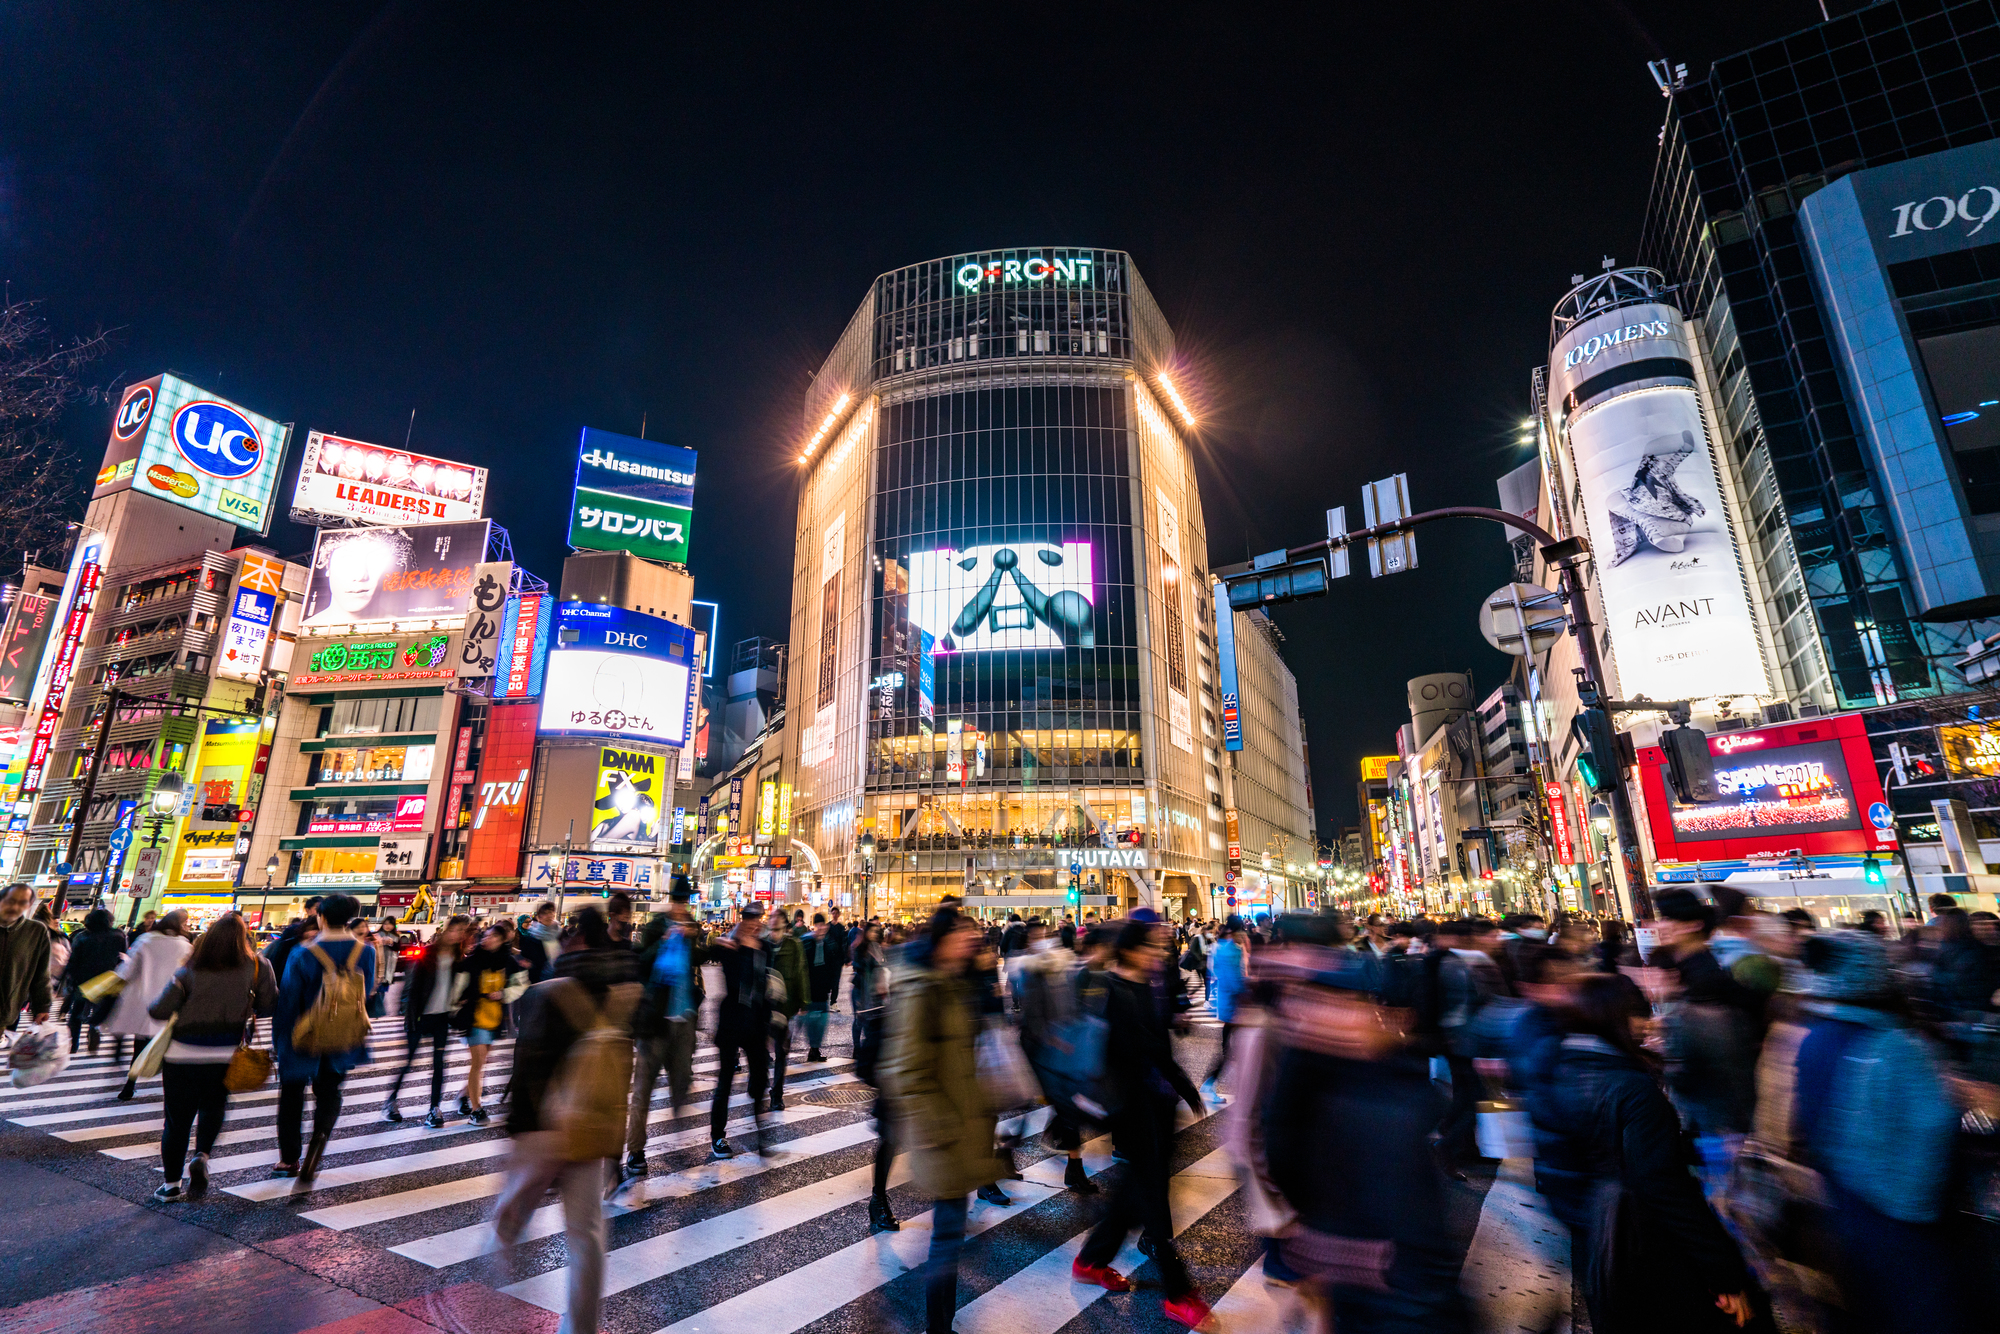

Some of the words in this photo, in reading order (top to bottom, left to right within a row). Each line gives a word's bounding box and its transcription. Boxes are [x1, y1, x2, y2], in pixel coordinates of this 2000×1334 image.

[1889, 185, 2000, 239] 109
[957, 258, 1092, 293] QFRONT
[117, 397, 148, 428] UC
[184, 410, 255, 466] UC
[148, 469, 199, 494] MasterCard
[581, 449, 693, 486] Hisamitsu
[225, 497, 260, 518] VISA
[336, 483, 431, 515] LEADERS
[579, 506, 684, 544] サロンパス
[443, 587, 470, 599] 2017
[33, 598, 49, 629] TOKYO
[461, 573, 506, 674] もんじゃ
[561, 608, 579, 617] DHC
[579, 609, 611, 618] Channel
[1635, 597, 1715, 629] AVANT
[235, 636, 257, 649] まで
[507, 600, 535, 692] 三千里薬品
[604, 630, 648, 649] DHC
[347, 650, 396, 670] 西村
[1223, 692, 1240, 740] SEIBU
[1716, 736, 1765, 753] Glico
[322, 767, 399, 783] Euphoria
[602, 749, 655, 774] DMM
[599, 769, 637, 792] FX
[729, 781, 741, 832] 洋服の青山
[133, 853, 151, 893] 道玄坂
[536, 860, 652, 884] 大盛堂書店
[1058, 850, 1147, 867] TSUTAYA
